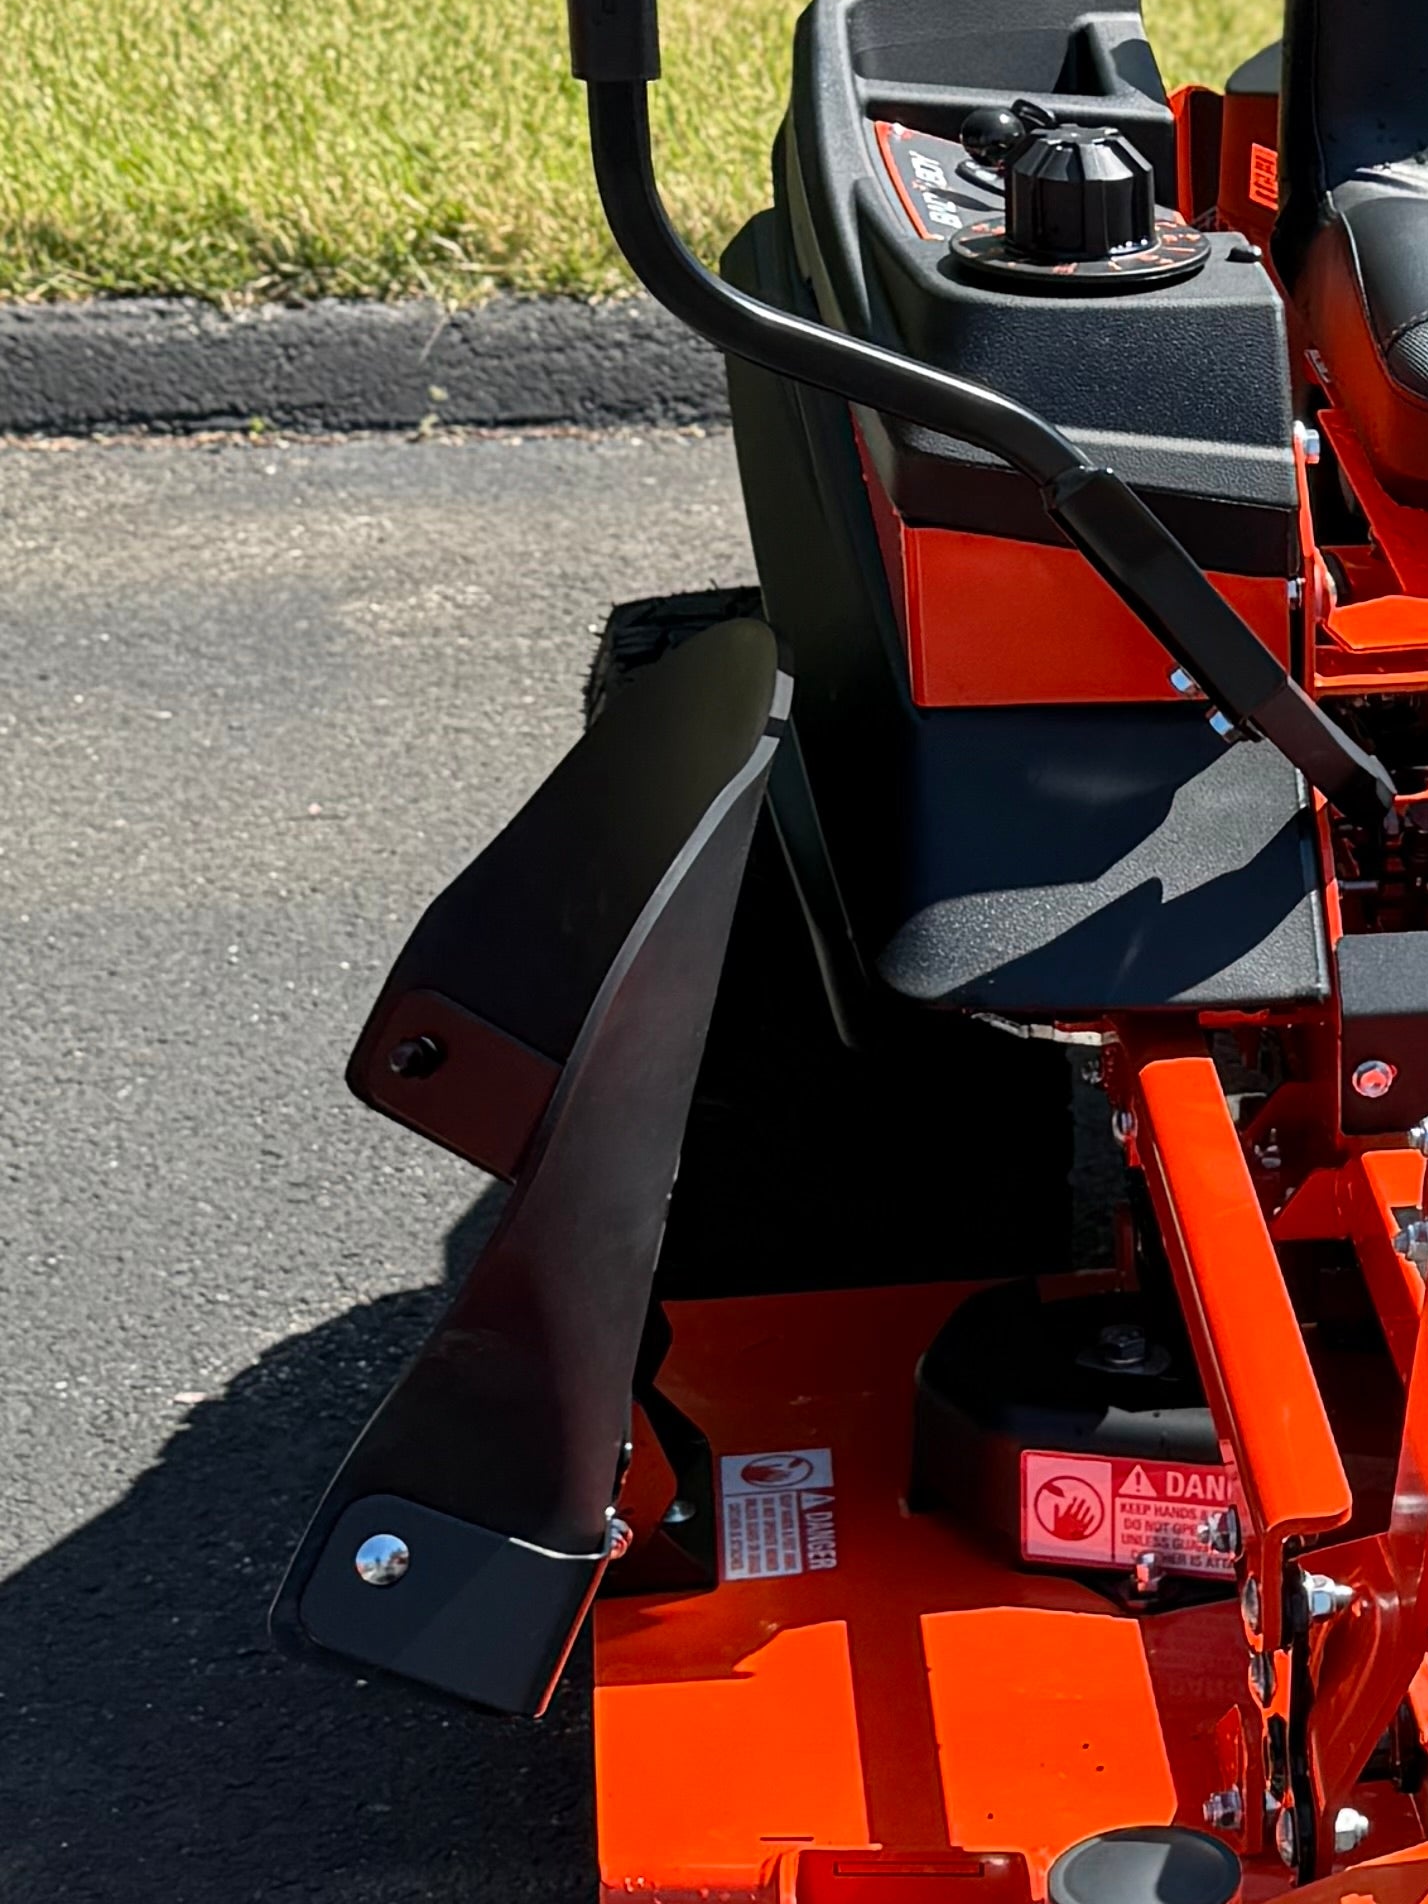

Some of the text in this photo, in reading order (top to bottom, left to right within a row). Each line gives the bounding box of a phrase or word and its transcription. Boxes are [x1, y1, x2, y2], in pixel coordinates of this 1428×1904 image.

[1165, 1470, 1232, 1500] DAN
[1120, 1502, 1151, 1516] KEEP
[1154, 1505, 1196, 1520] HANDS
[1123, 1517, 1142, 1531] DO
[805, 1511, 838, 1571] DANGER
